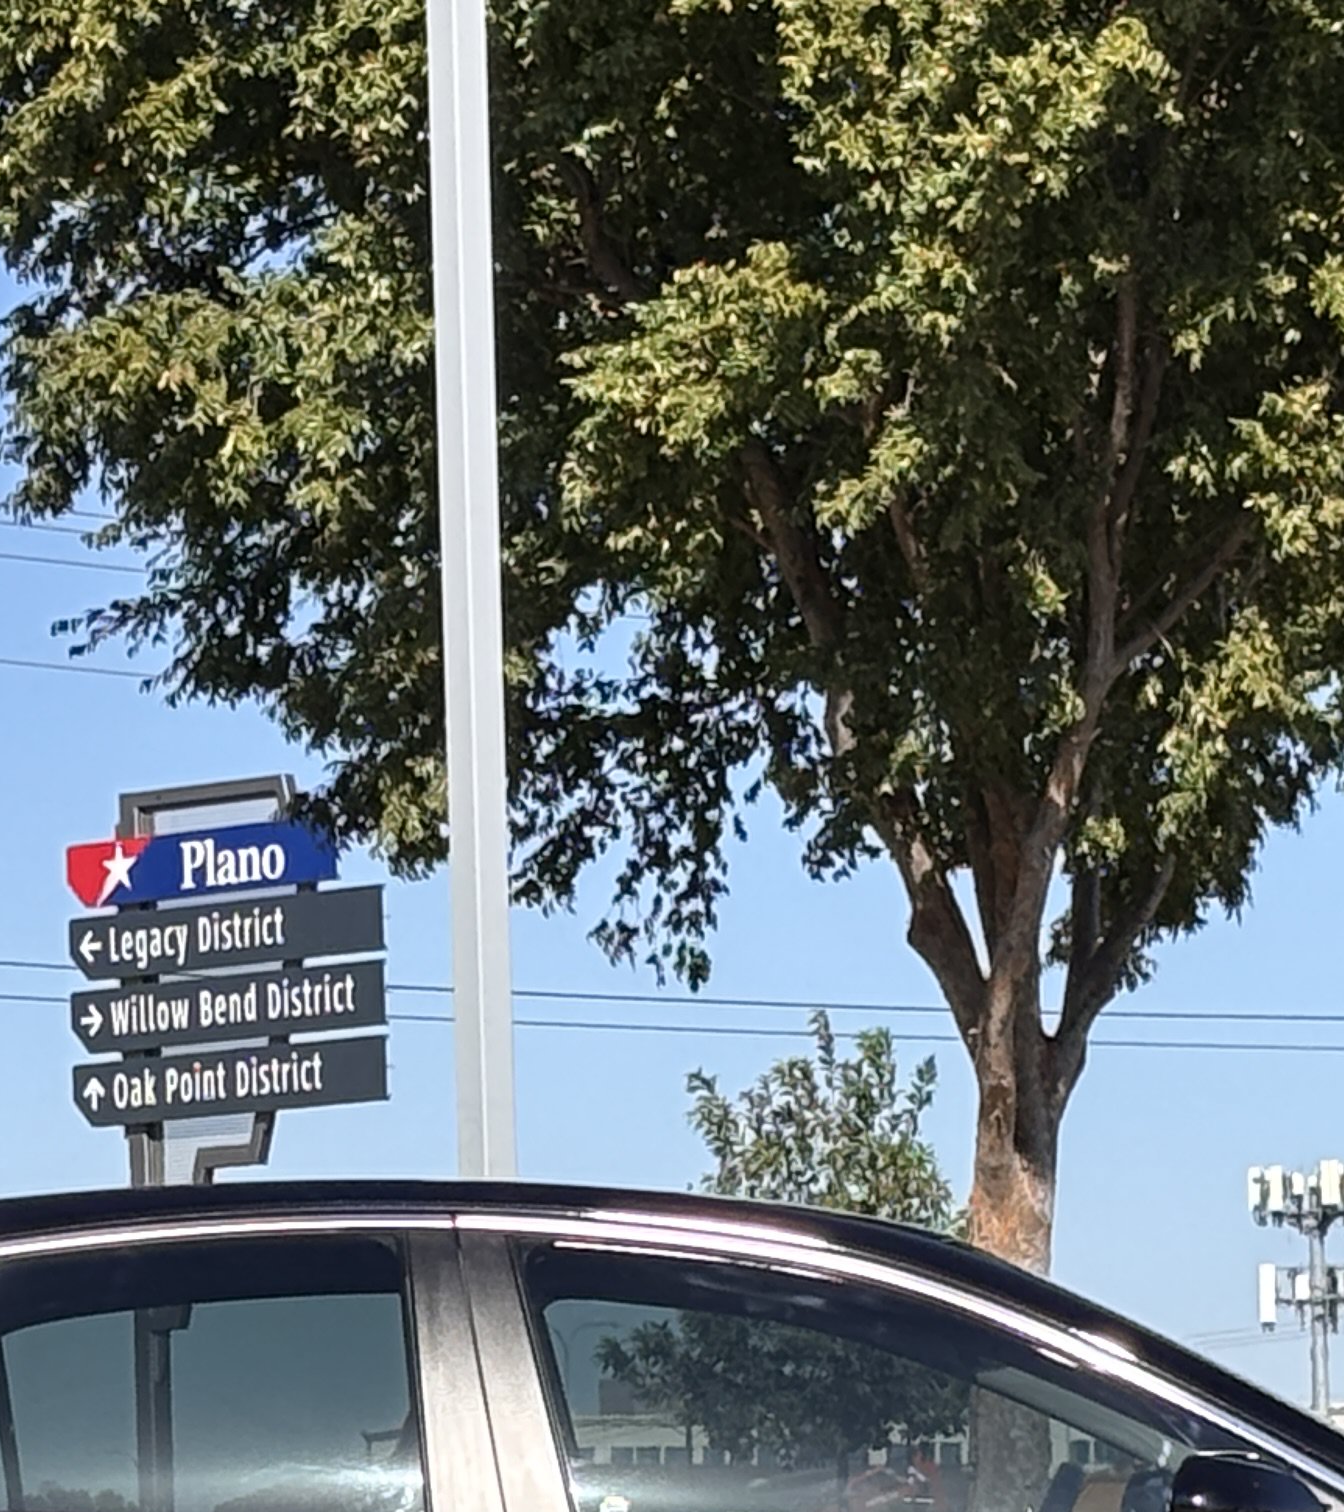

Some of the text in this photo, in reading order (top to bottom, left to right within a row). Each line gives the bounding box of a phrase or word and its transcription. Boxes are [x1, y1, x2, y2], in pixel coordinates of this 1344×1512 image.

[179, 838, 286, 890] Plano
[109, 906, 285, 969] Legacy District
[110, 973, 355, 1036] Willow Bend District
[113, 1052, 323, 1110] Oak Point District
